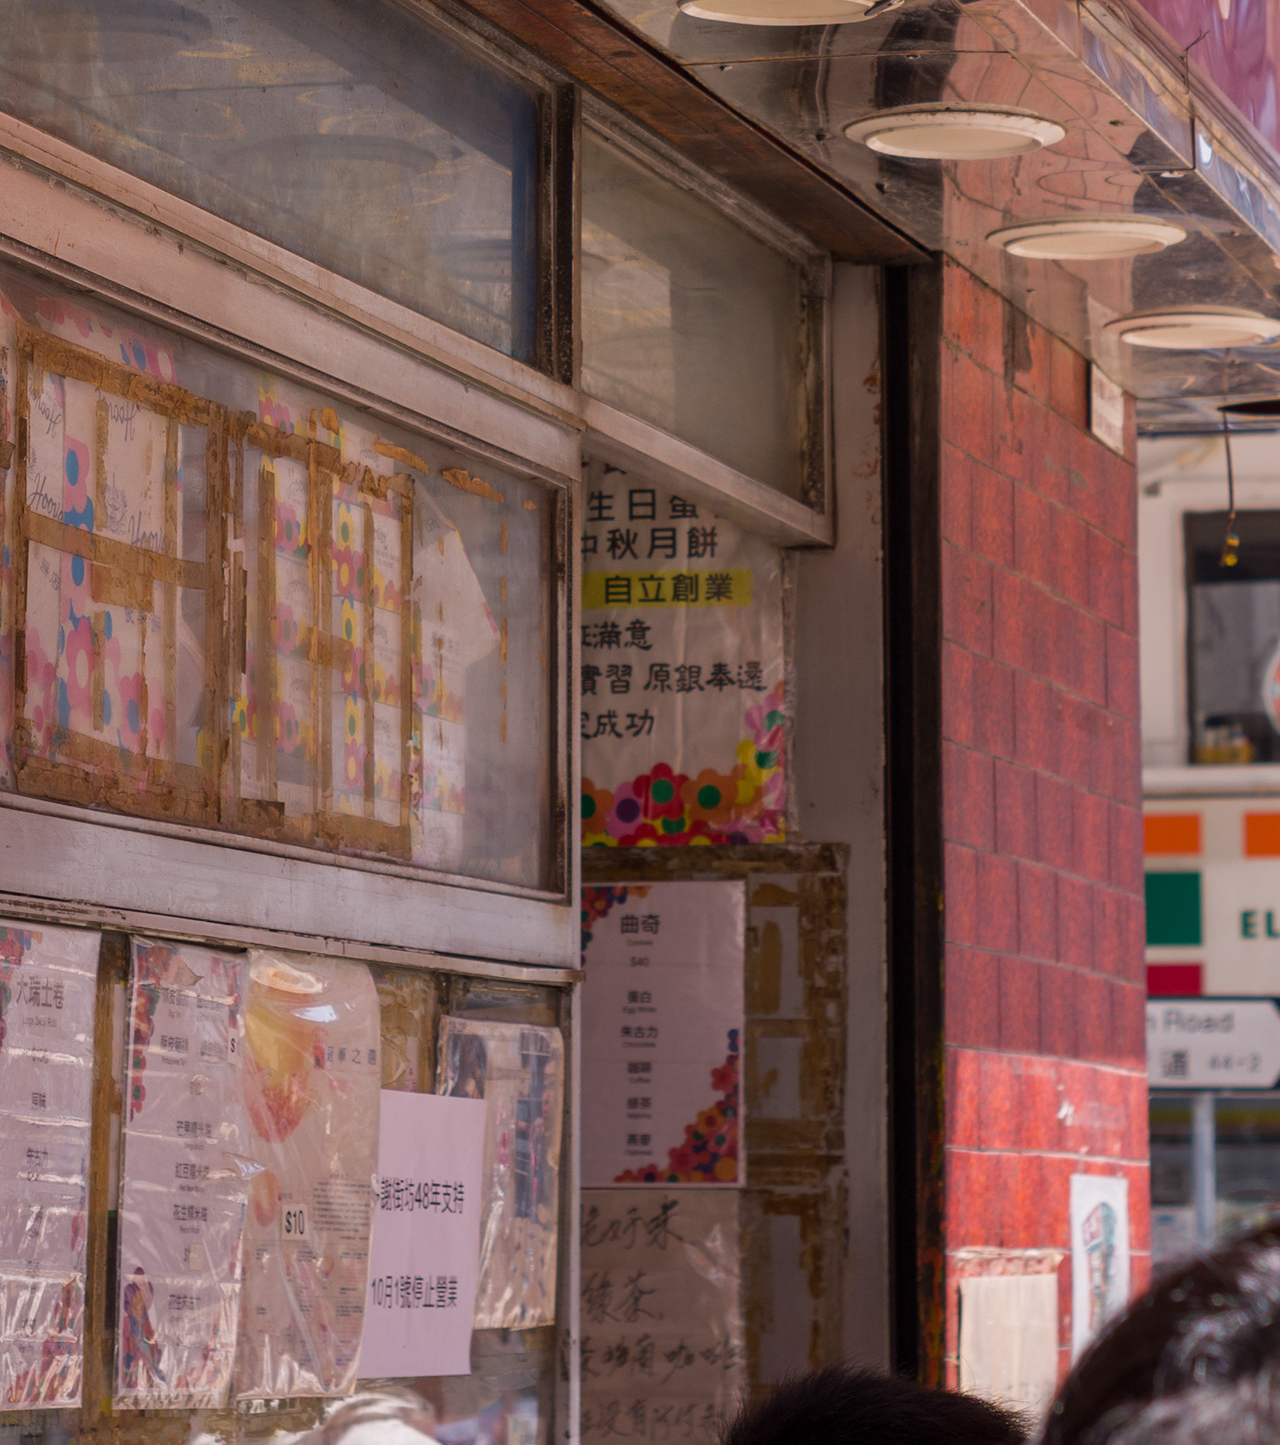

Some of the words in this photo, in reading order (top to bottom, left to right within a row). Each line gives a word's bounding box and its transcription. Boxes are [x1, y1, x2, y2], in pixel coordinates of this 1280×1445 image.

[603, 573, 734, 606] 自立創業
[643, 661, 769, 694] 原銀奉還
[620, 914, 661, 936] 曲奇
[630, 956, 650, 968] $40
[16, 973, 65, 1010] 大瑞士卷
[627, 990, 653, 1005] 蛋白
[621, 1026, 660, 1040] 朱古力
[1162, 1007, 1235, 1034] Road
[375, 1176, 465, 1215] 謝街坊48年支持
[285, 1210, 305, 1236] $10
[371, 1275, 459, 1309] 10月1號停止營業
